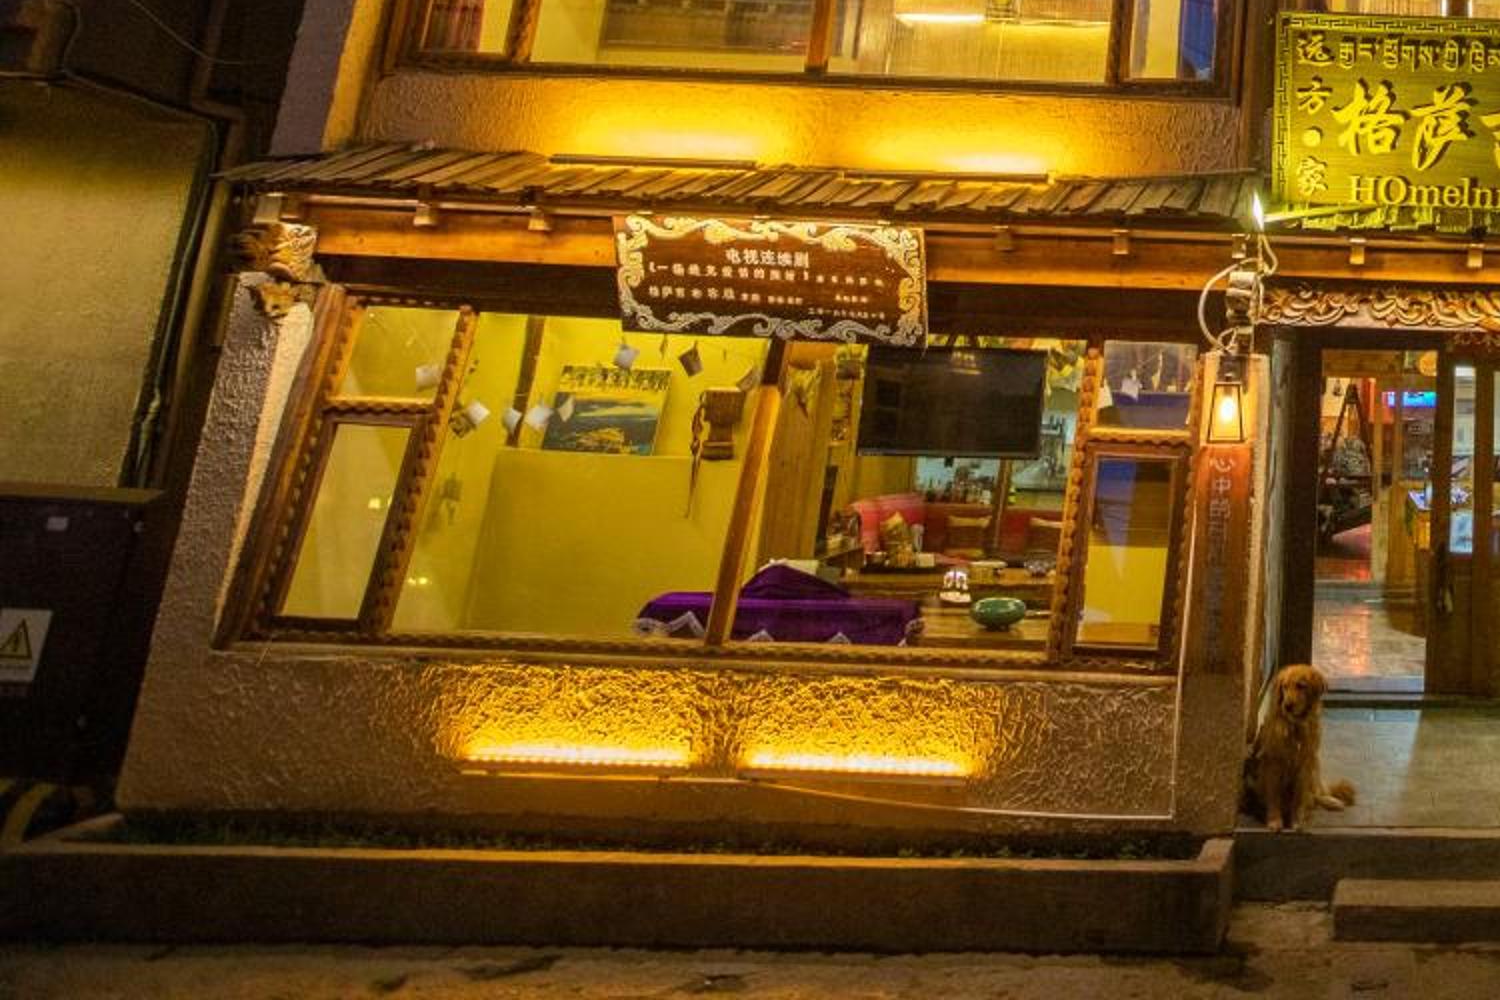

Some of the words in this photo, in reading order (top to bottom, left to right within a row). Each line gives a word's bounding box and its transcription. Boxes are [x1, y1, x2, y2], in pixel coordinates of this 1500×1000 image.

[725, 248, 810, 269] 电视连续剧
